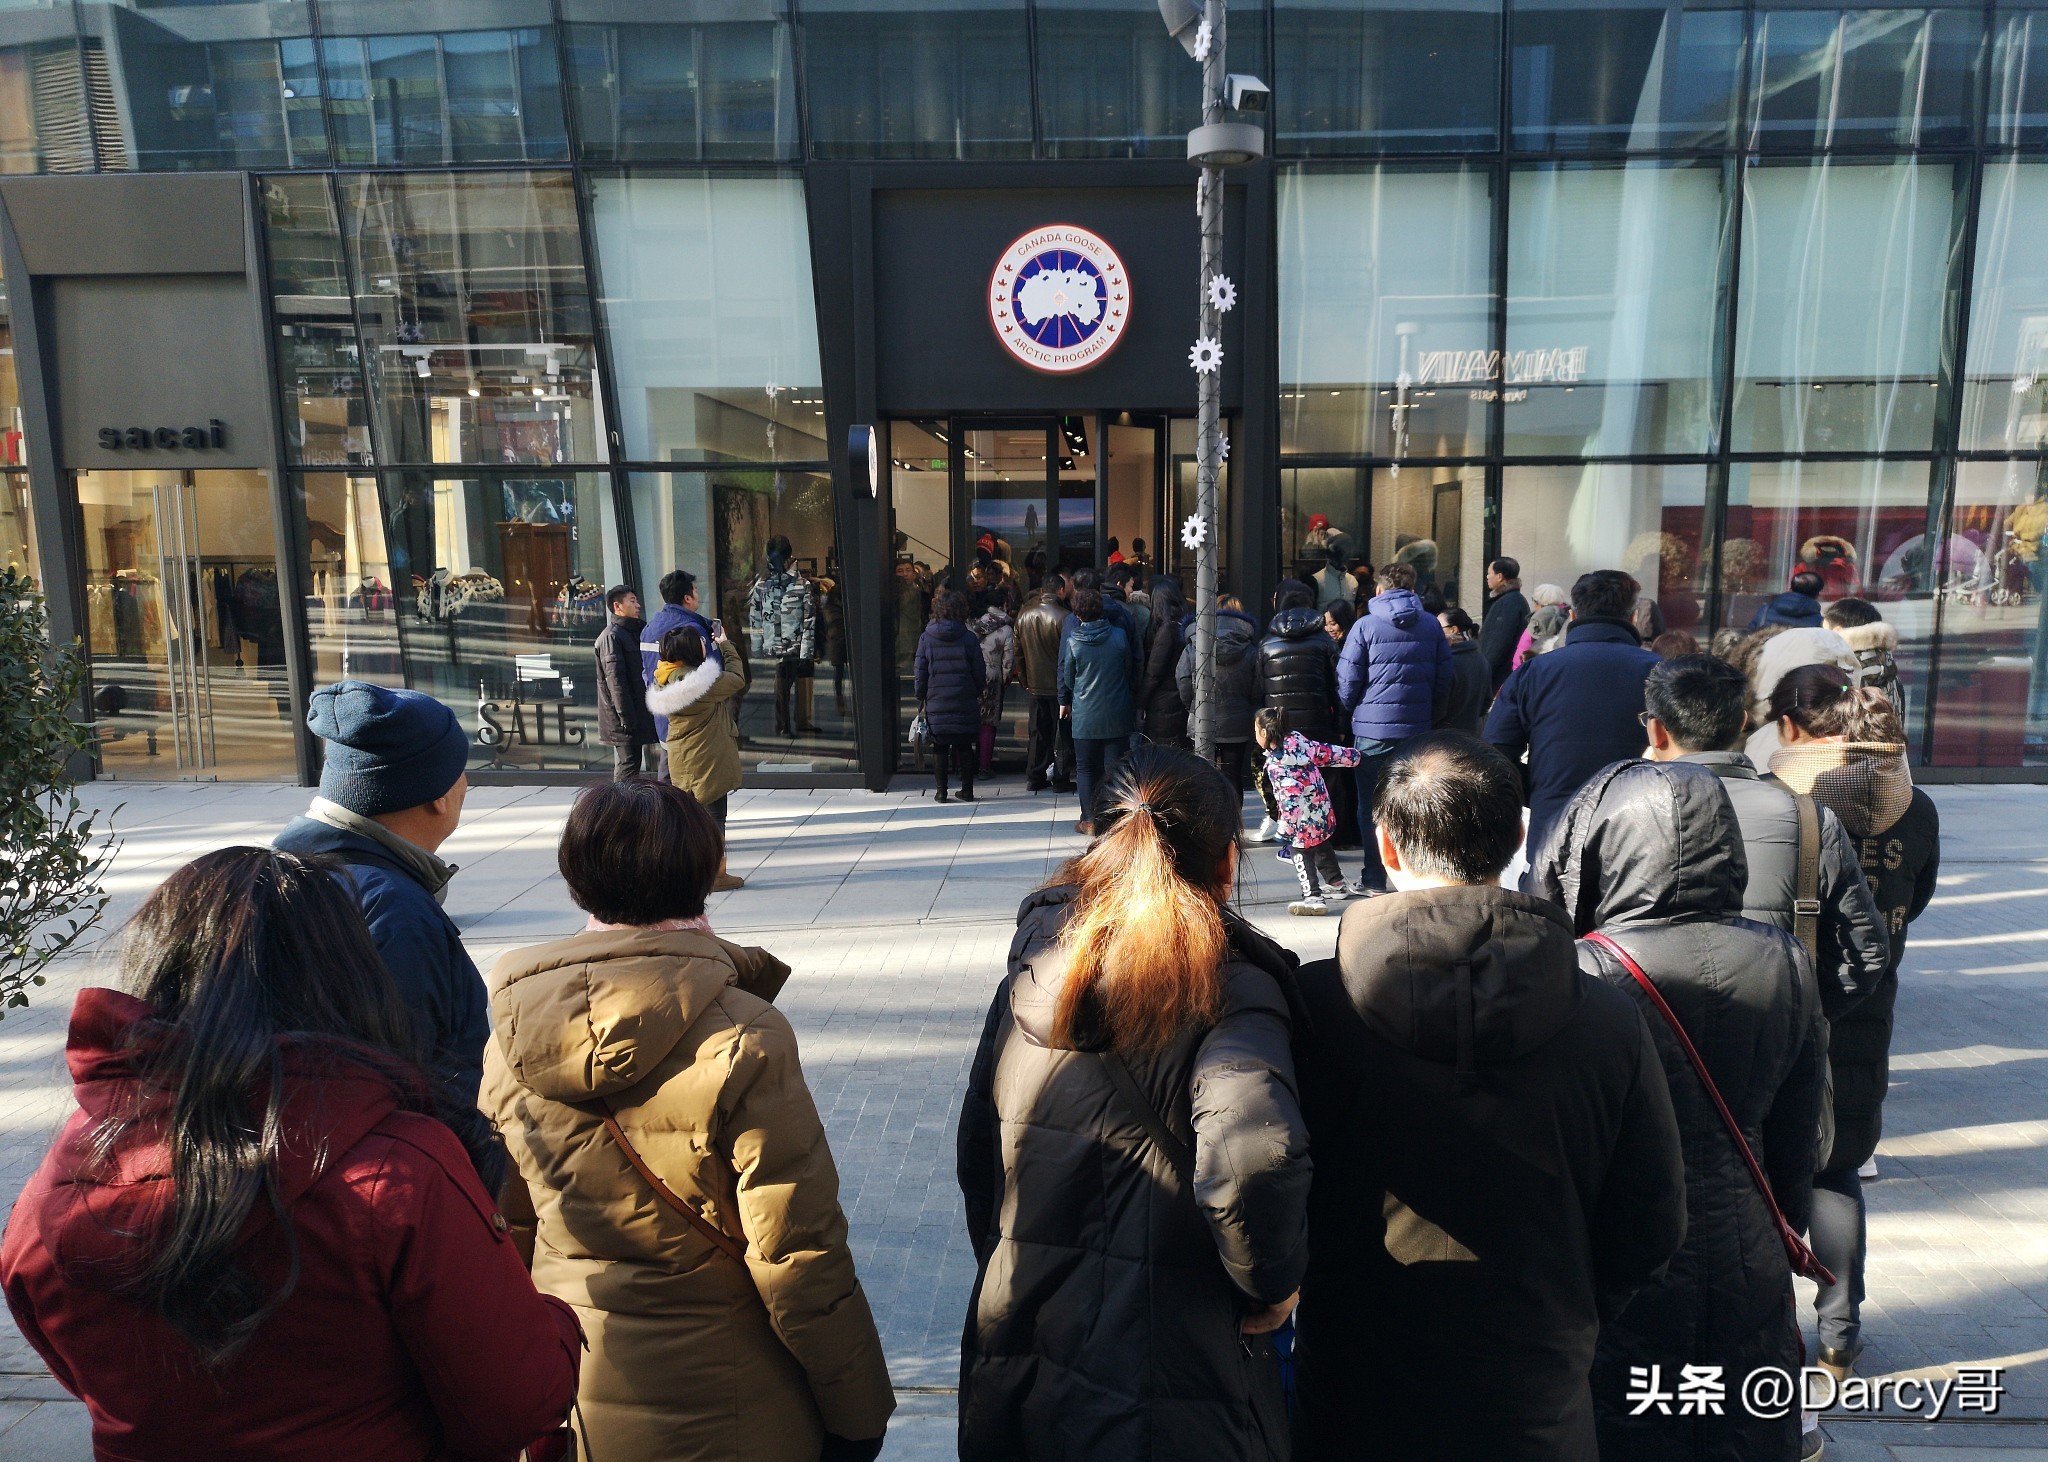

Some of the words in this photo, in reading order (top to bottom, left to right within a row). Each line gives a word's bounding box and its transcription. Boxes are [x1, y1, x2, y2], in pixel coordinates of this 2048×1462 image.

[1017, 233, 1062, 256] CANADA
[1065, 233, 1102, 256] GOOSE
[1013, 337, 1051, 362] ARCTIC
[1054, 336, 1107, 363] PROGRAM
[98, 419, 224, 450] sacai
[477, 702, 584, 753] SALE
